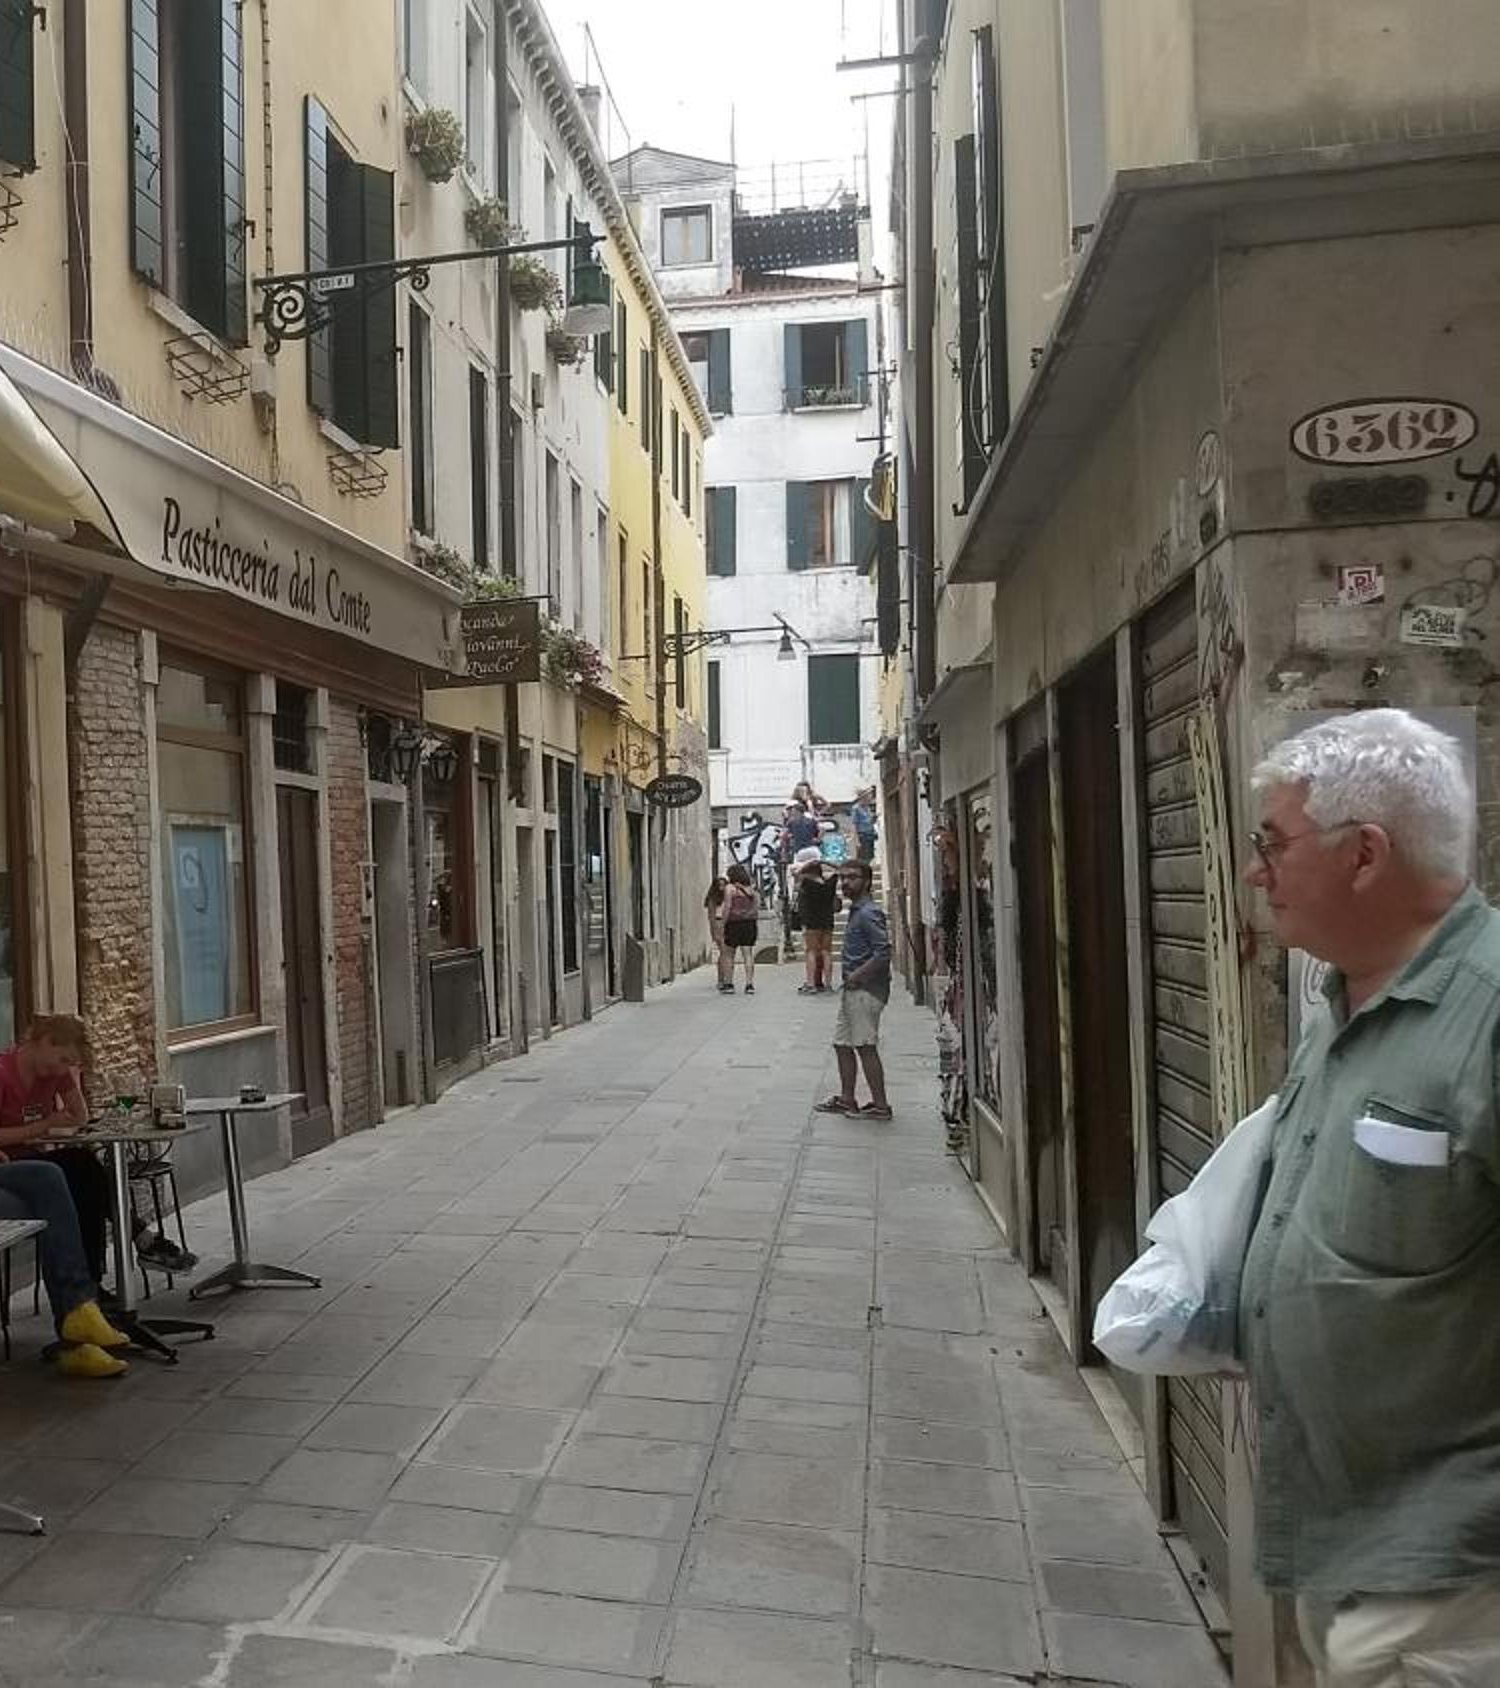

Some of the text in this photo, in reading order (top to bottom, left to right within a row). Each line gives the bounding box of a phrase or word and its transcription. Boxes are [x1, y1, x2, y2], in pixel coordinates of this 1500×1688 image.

[161, 497, 372, 634] Pasticceria dal Conte
